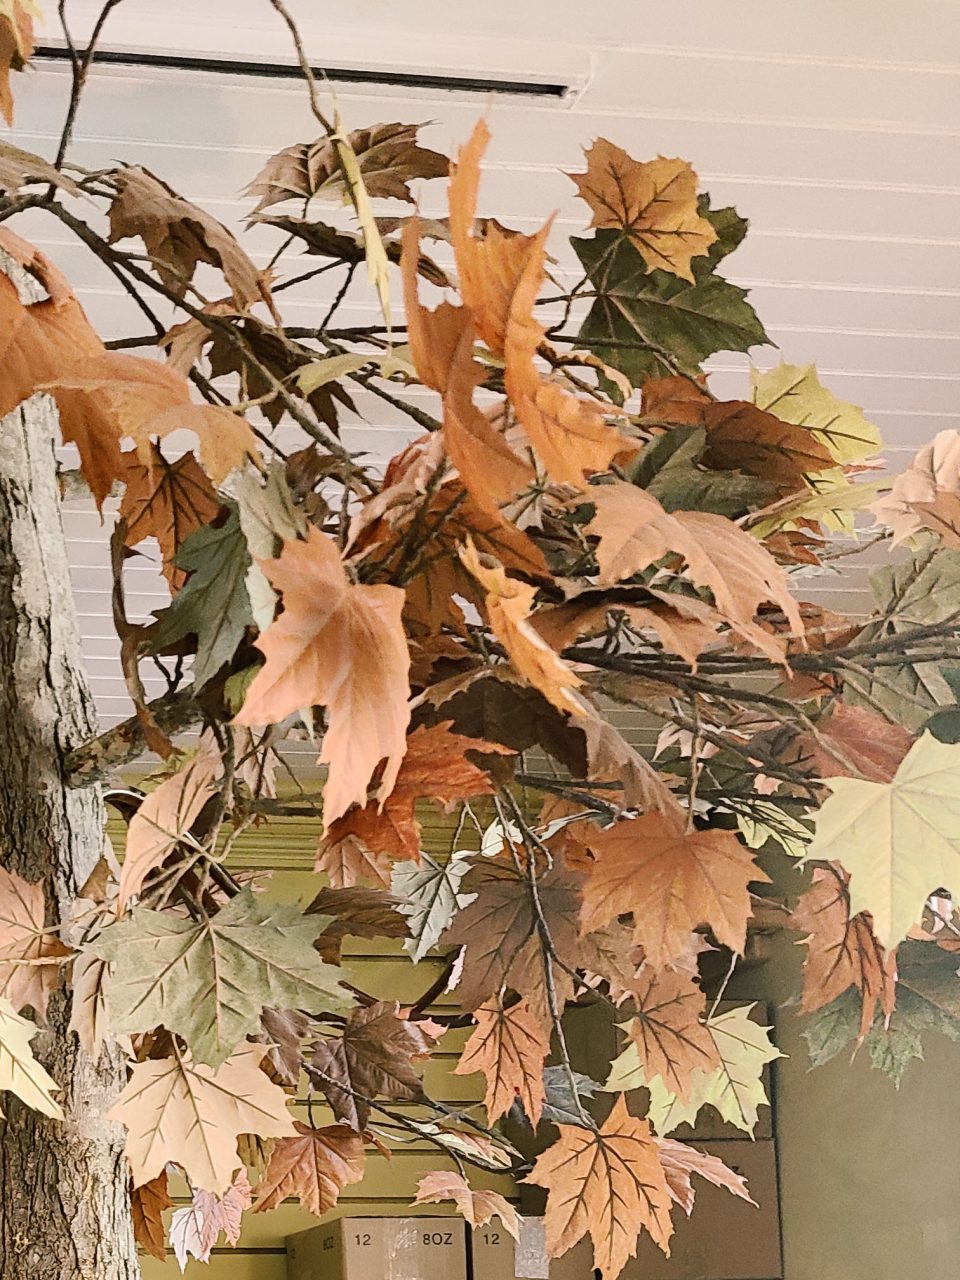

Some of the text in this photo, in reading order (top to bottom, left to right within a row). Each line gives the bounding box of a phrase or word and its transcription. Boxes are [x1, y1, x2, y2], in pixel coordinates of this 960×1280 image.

[354, 1233, 453, 1245] 12 8OZ
[483, 1233, 500, 1245] 12
